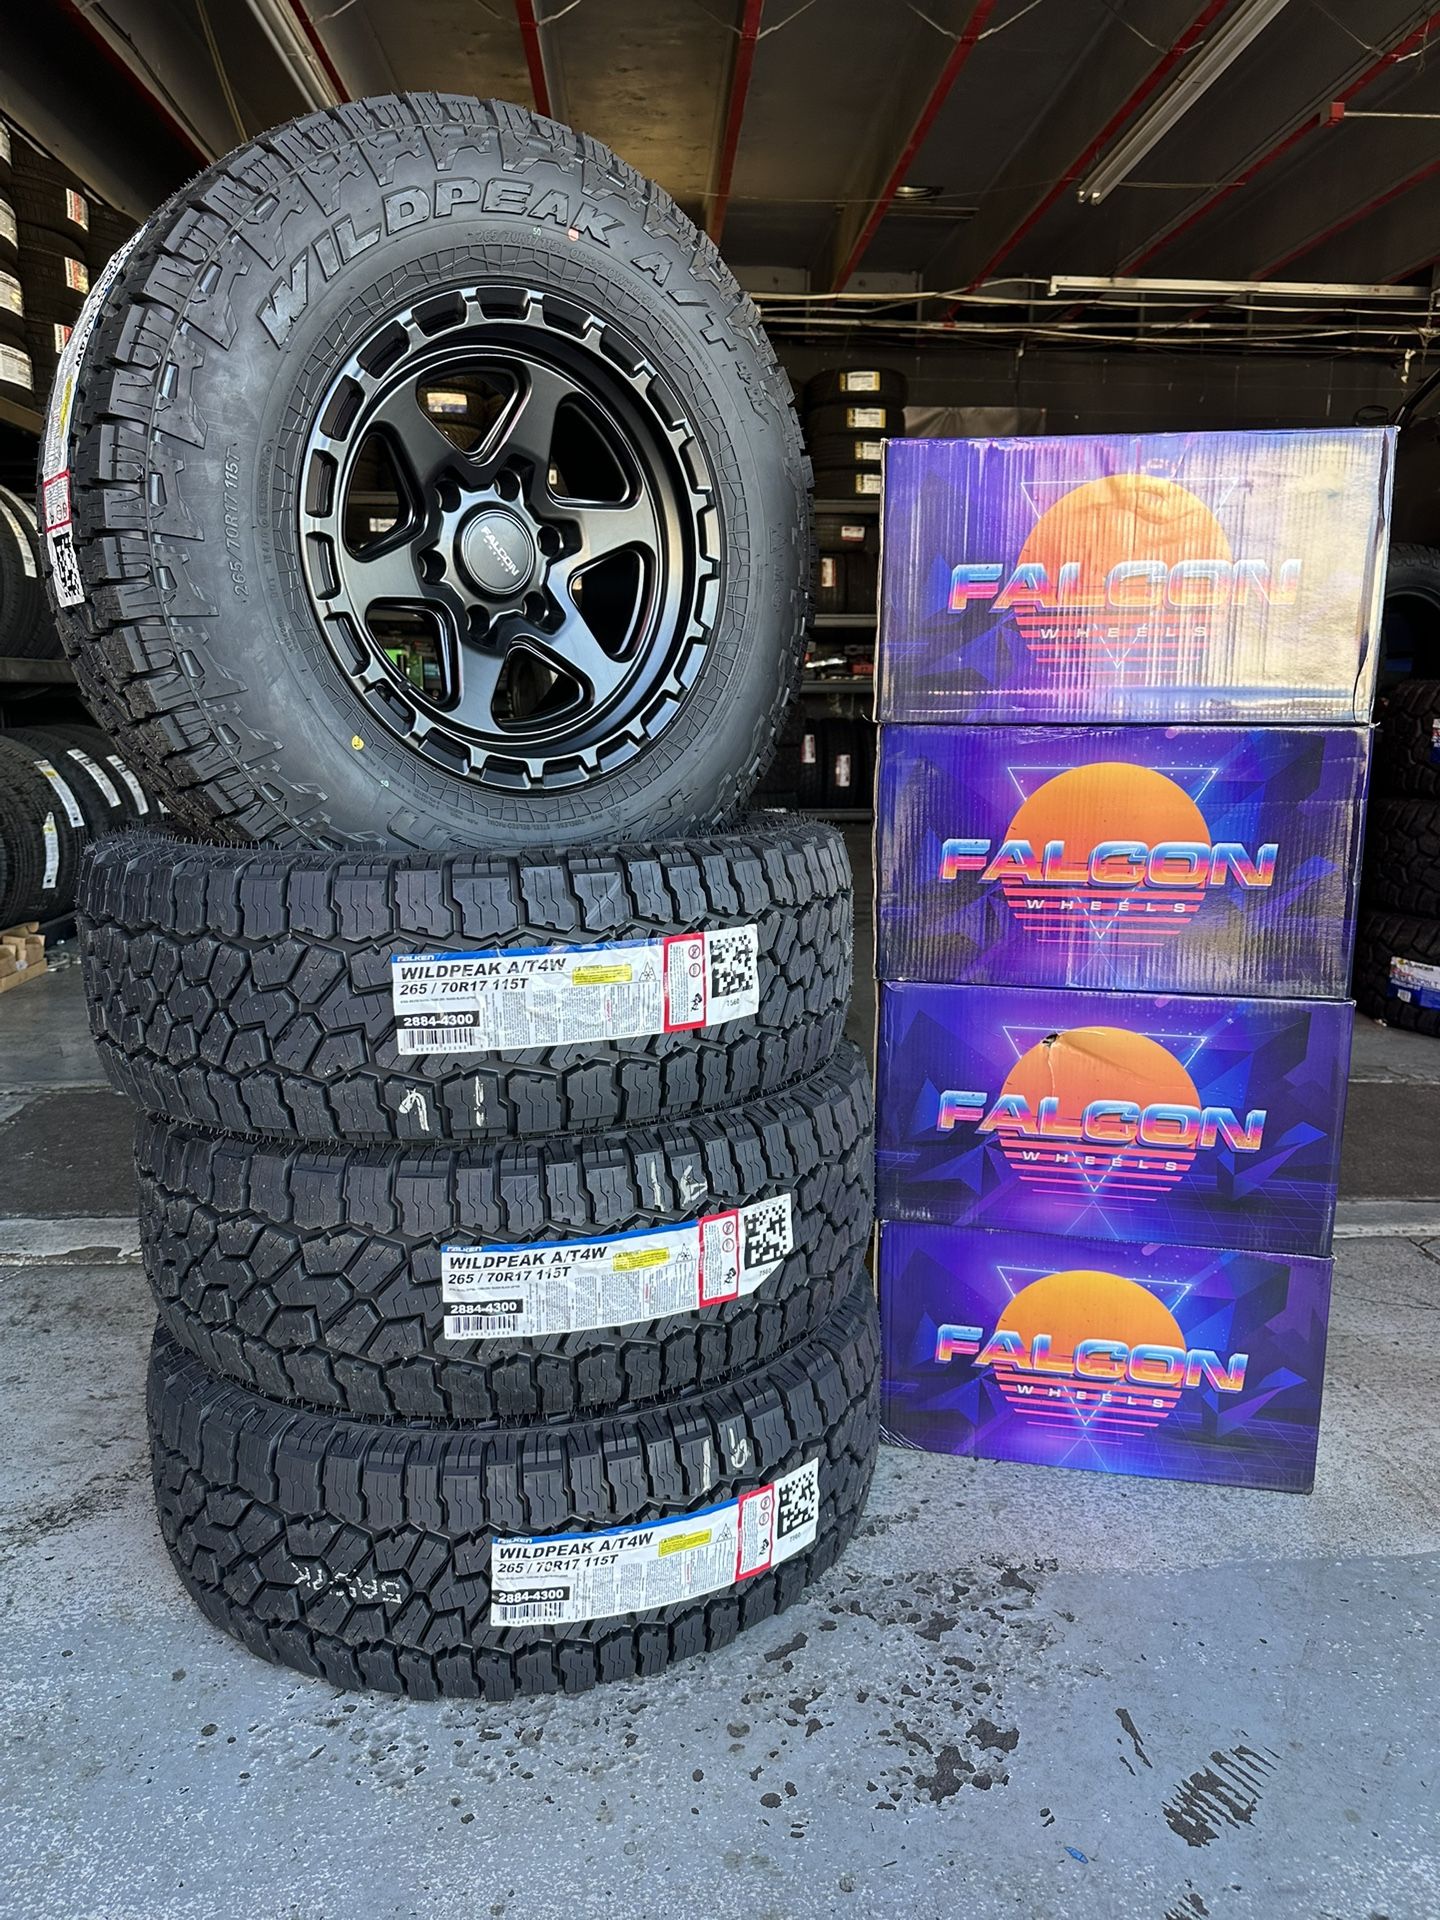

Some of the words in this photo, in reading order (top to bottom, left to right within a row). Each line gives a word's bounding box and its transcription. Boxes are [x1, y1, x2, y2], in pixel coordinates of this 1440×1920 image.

[256, 177, 625, 350] WILDPEAK
[224, 445, 241, 489] 115T
[223, 491, 250, 599] 265/70R17
[480, 525, 520, 577] FALCON
[947, 558, 1302, 614] FALCON
[1039, 625, 1207, 639] WHEELS
[939, 838, 1279, 888] FALCON
[1026, 899, 1187, 913] WHEELS
[401, 962, 502, 981] WILDPEAK
[507, 958, 567, 975] A/T4W
[400, 983, 427, 996] 265
[441, 979, 489, 994] 70R17
[493, 977, 530, 991] 115T
[403, 1013, 474, 1027] 2884-4300
[937, 1090, 1267, 1153] FALCON
[1021, 1151, 1178, 1172] WHEELS
[450, 1252, 547, 1269] WILDPEAK
[551, 1246, 608, 1264] A/T4W
[448, 1273, 474, 1285] 265
[487, 1270, 533, 1283] 70R17
[537, 1266, 572, 1280] 115T
[450, 1302, 517, 1315] 2884-4300
[934, 1324, 1249, 1393] FALCON
[1017, 1384, 1165, 1408] WHEELS
[499, 1541, 595, 1559] WILDPEAK
[598, 1532, 654, 1552] A/T4W
[497, 1562, 524, 1573] 265
[536, 1558, 580, 1573] 70R17
[584, 1554, 619, 1568] 115T
[498, 1588, 565, 1604] 2884-4300
